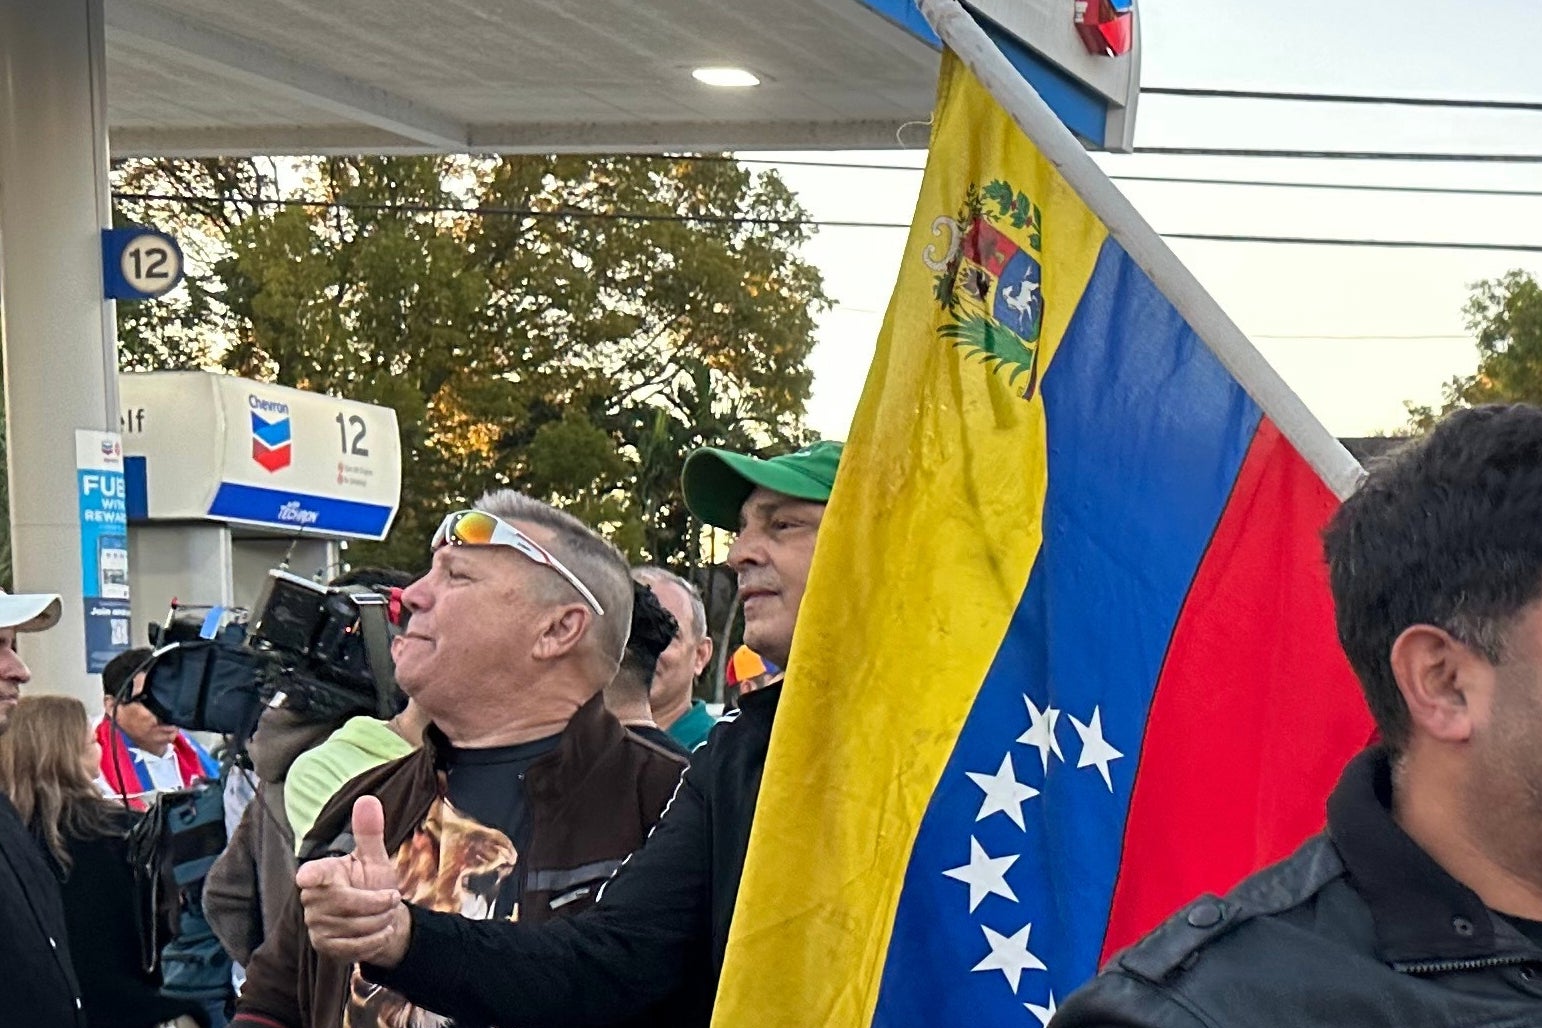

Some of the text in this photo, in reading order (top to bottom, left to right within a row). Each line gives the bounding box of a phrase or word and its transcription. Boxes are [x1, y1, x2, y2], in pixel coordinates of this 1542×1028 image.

[129, 247, 169, 279] 12
[248, 394, 289, 414] Chevron
[336, 411, 369, 457] 12
[83, 475, 125, 498] FUE
